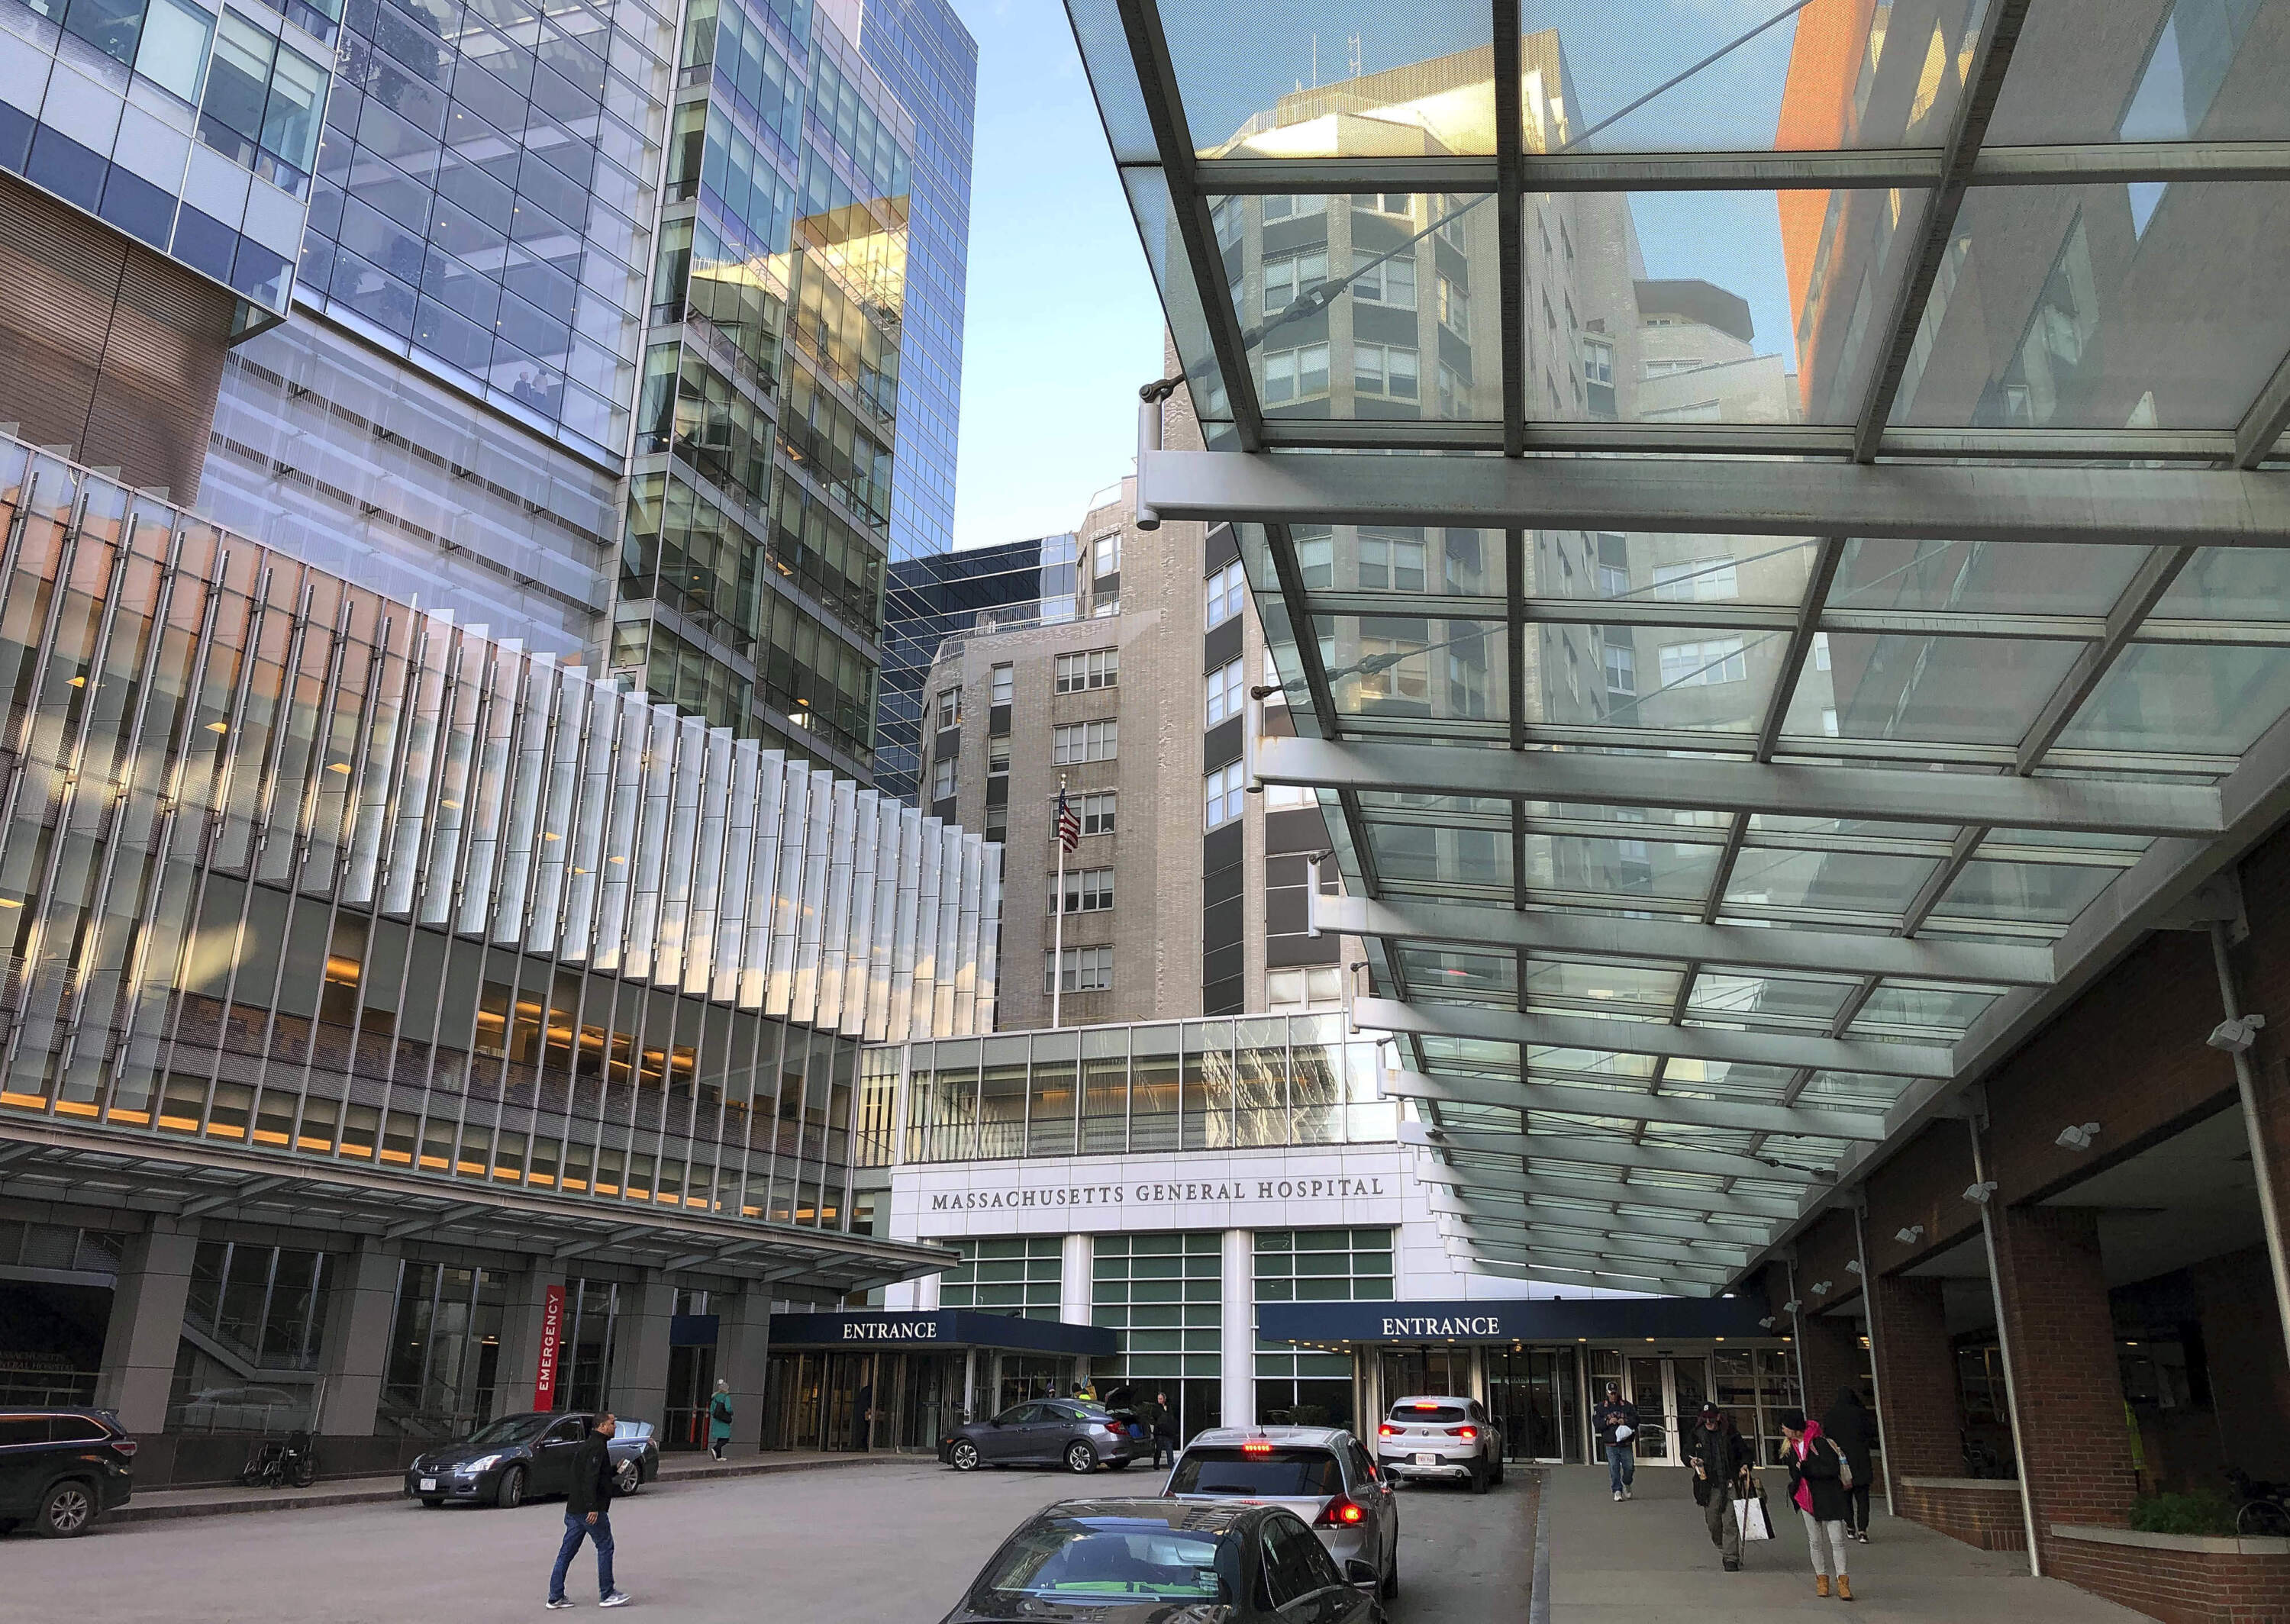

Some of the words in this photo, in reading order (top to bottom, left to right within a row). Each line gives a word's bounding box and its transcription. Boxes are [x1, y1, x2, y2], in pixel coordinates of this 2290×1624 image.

[931, 1186, 1124, 1210] MASSACHUSETTS
[1136, 1183, 1245, 1201] GENERAL
[1257, 1178, 1383, 1198] HOSPITAL
[843, 1322, 937, 1339] ENTRANCE
[1382, 1317, 1500, 1336] ENTRANCE
[539, 1294, 559, 1390] EMERGENCY
